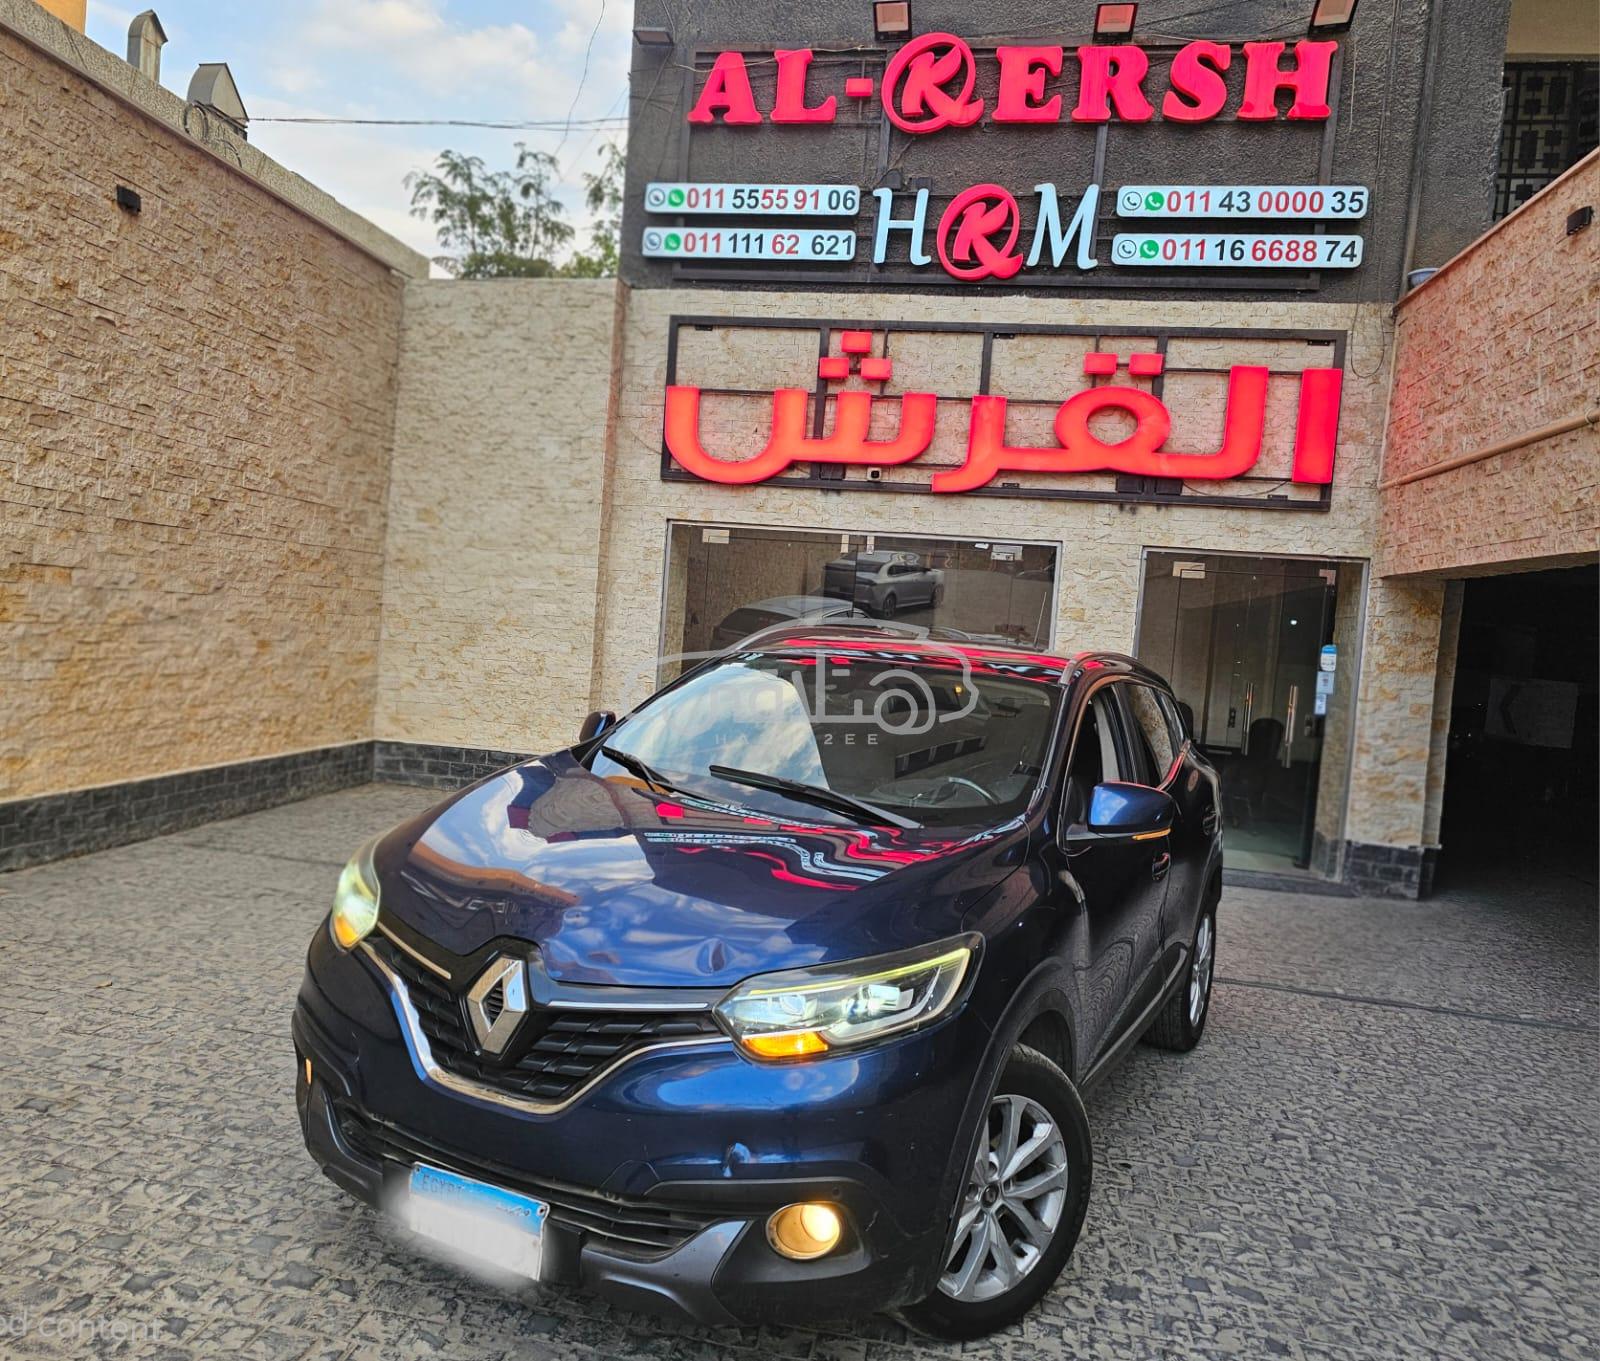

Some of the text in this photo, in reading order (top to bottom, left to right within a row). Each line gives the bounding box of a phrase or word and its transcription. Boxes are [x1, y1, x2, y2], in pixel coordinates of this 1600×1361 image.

[686, 187, 725, 210] 011
[732, 188, 789, 210] 5555
[828, 189, 856, 211] 06
[1166, 190, 1365, 214] 011 43 0000 35
[683, 231, 853, 256] 011 111 62 621
[1161, 237, 1358, 263] 011 16 6688 74
[664, 330, 1344, 493] القرش
